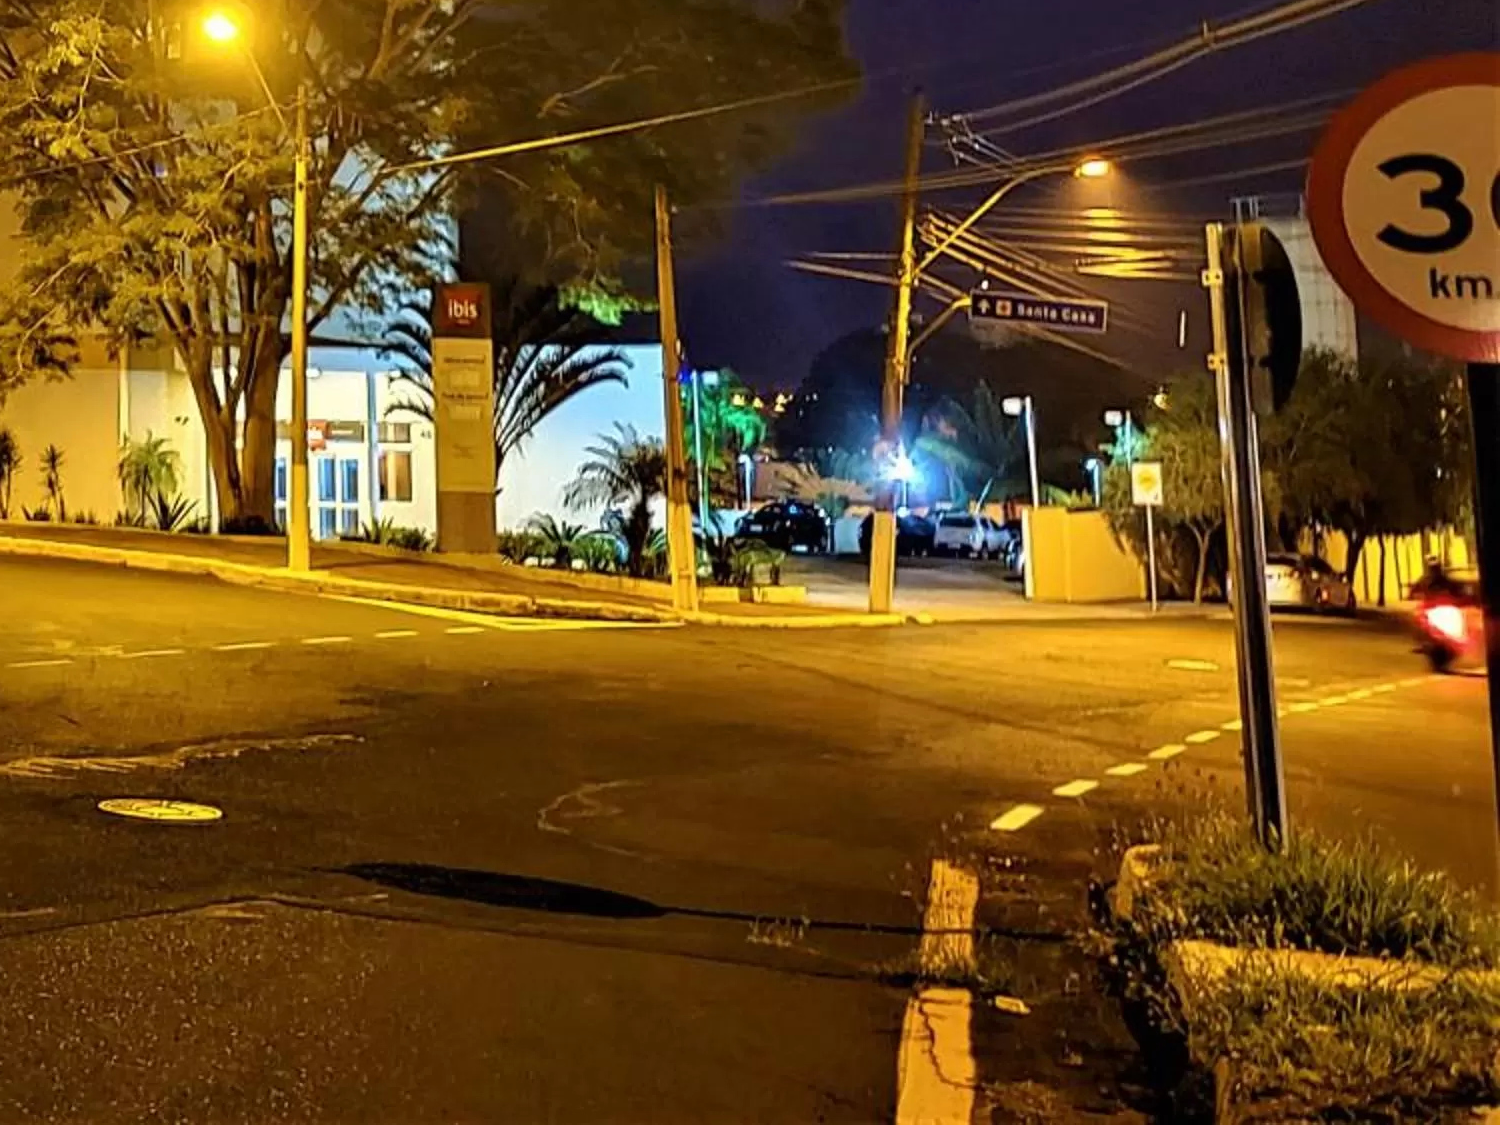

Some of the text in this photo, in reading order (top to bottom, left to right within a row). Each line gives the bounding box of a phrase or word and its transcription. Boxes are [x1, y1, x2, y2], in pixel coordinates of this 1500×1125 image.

[1375, 152, 1500, 254] 3
[1428, 266, 1500, 300] km
[448, 298, 478, 319] ibis
